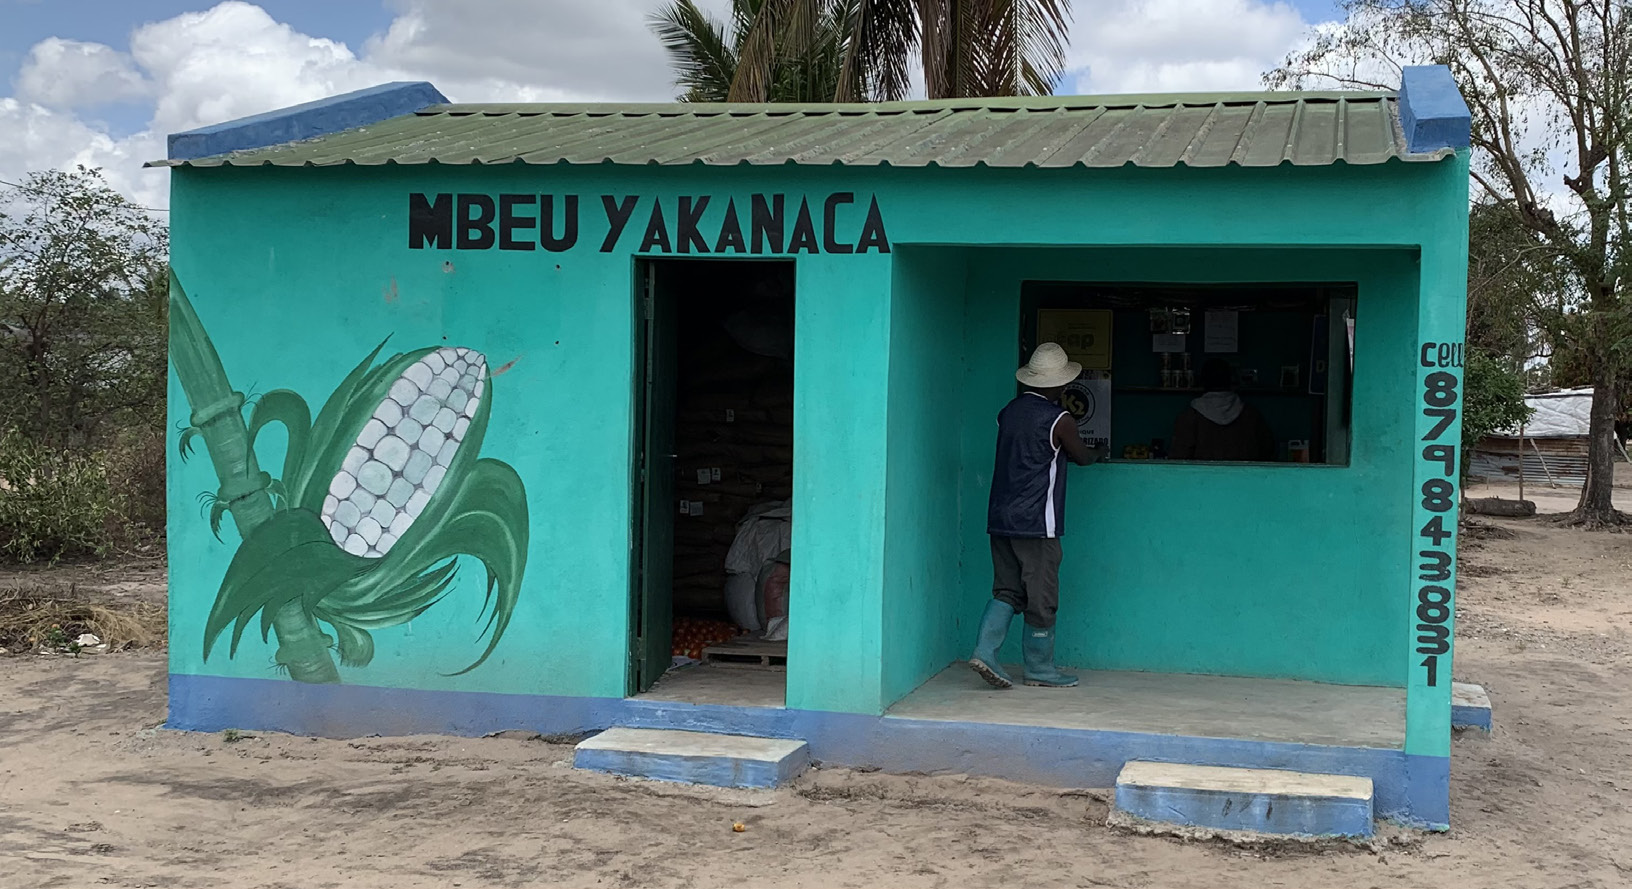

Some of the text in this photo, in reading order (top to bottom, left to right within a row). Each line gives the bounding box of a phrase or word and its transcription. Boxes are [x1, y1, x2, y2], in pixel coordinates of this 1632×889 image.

[408, 191, 891, 255] MBEU YAKANACA
[1415, 370, 1458, 688] 879843831
